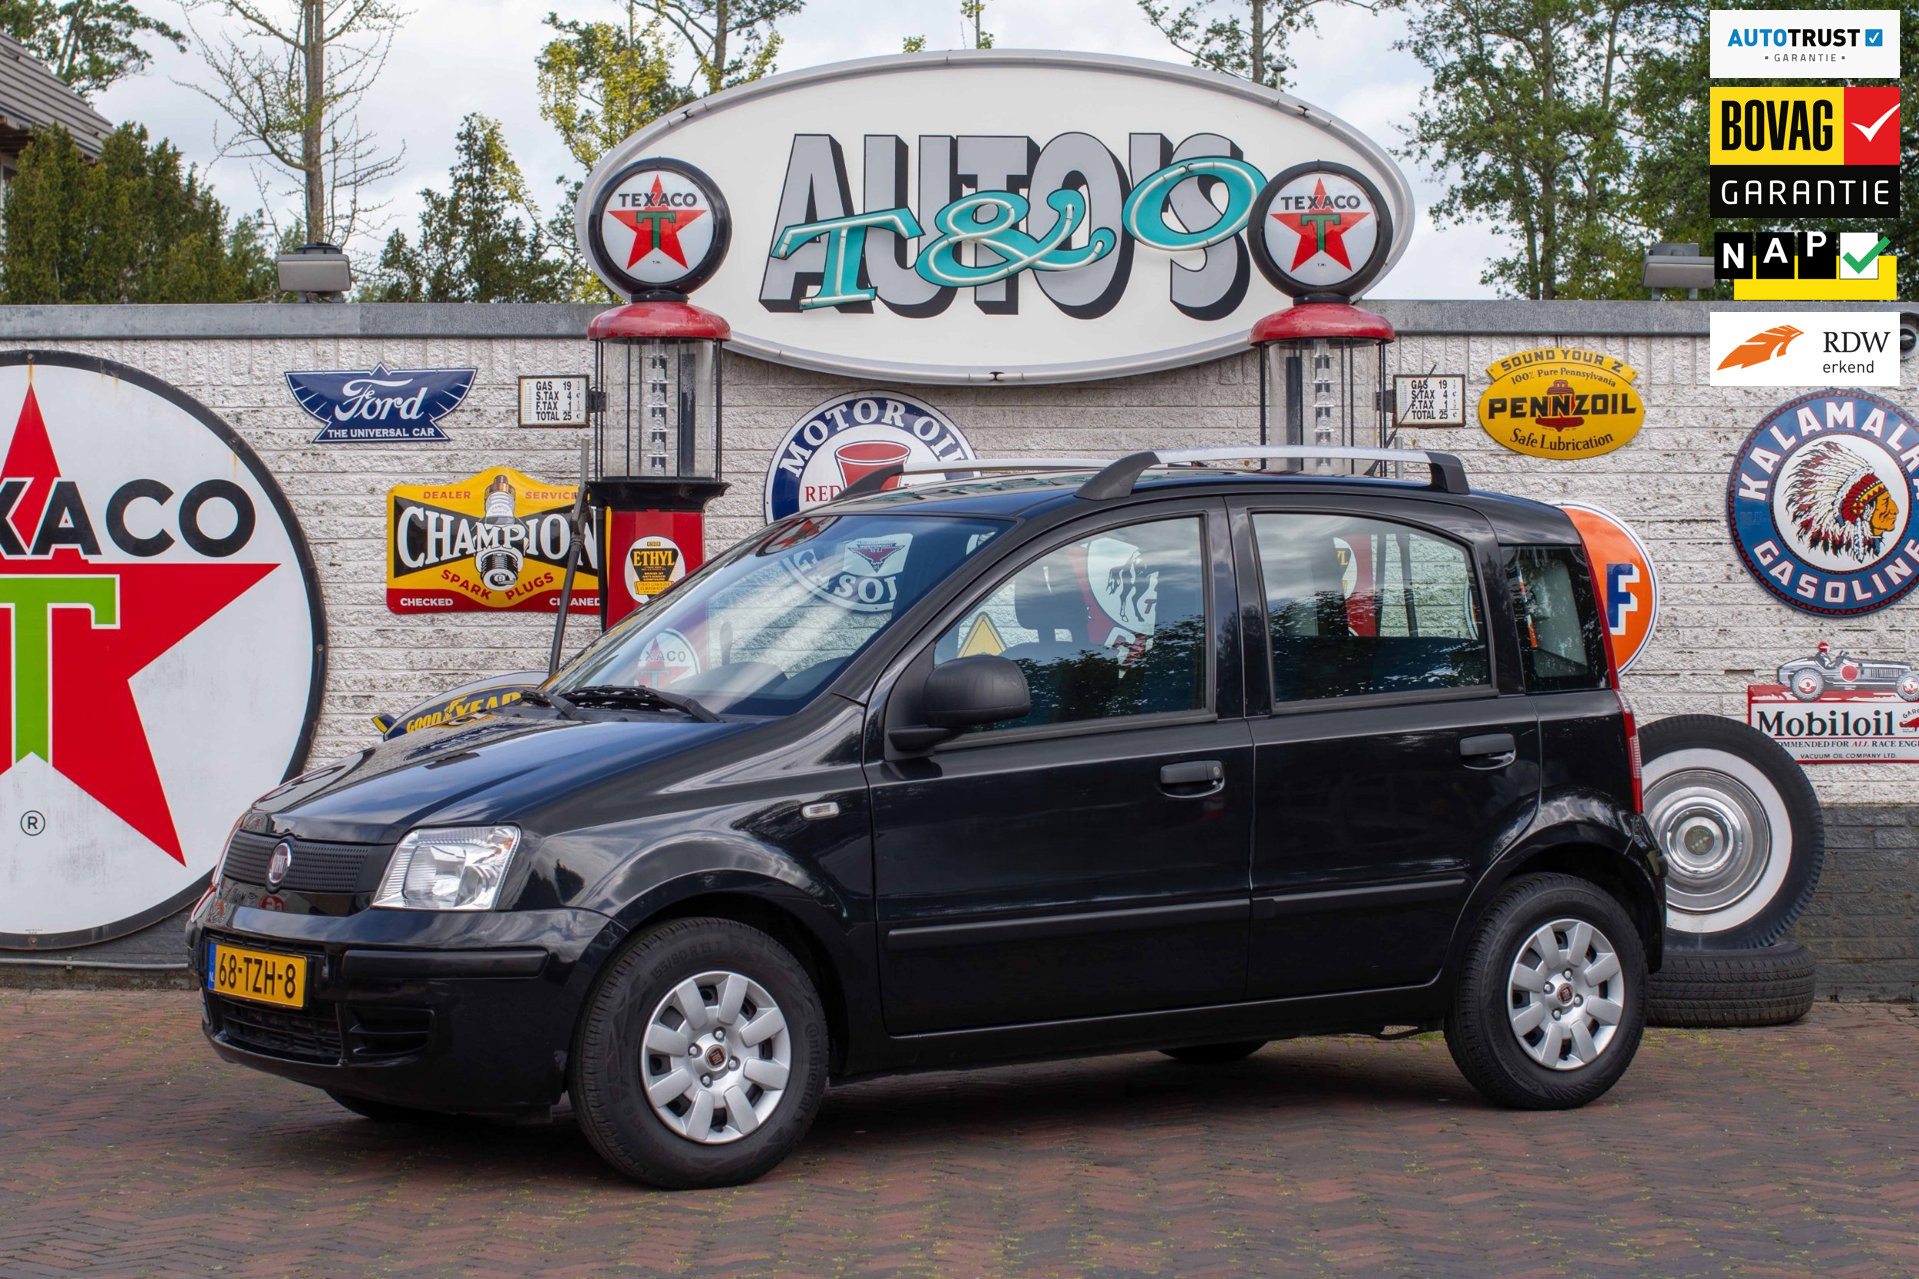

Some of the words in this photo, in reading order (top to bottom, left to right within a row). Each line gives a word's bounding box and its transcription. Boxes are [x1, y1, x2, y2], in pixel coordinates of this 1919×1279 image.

[618, 192, 698, 207] TEXACO
[1281, 195, 1361, 210] TEXACO
[637, 211, 677, 250] T
[758, 131, 1250, 320] AUTO'S
[1300, 213, 1341, 252] T
[1500, 350, 1556, 372] SOUND
[1561, 349, 1604, 365] YOUR
[1610, 360, 1624, 373] Z
[1411, 380, 1428, 390] GAS
[1439, 380, 1448, 389] 19
[1537, 368, 1558, 378] Pure
[1560, 367, 1616, 388] Pennsylvania
[536, 381, 553, 391] GAS
[563, 381, 572, 391] 19
[334, 378, 428, 421] Ford
[536, 391, 559, 401] S.TAX
[567, 391, 572, 400] 4
[1443, 390, 1448, 399] 4
[536, 401, 558, 411] F.TAX
[1488, 393, 1637, 420] PENNZOIL
[536, 411, 560, 421] TOTAL
[563, 411, 572, 421] 25
[1411, 410, 1436, 420] TOTAL
[1439, 410, 1448, 420] 25
[328, 429, 349, 438] THE
[350, 428, 410, 438] UNIVERSAL
[412, 427, 435, 437] CAR
[779, 399, 906, 478] MOTOR
[1509, 427, 1538, 447] Safe
[1540, 433, 1614, 451] Lubrication
[423, 491, 471, 499] DEALER
[805, 485, 842, 502] RED
[397, 505, 599, 570] CHAMPION
[633, 550, 675, 566] ETHYL
[440, 569, 492, 600] SPARK
[505, 572, 555, 600] PLUGS
[400, 597, 454, 607] CHECKED
[549, 597, 601, 606] CANED
[1757, 709, 1895, 737] Mobiloil
[1831, 740, 1849, 748] FOR
[1872, 740, 1897, 748] RACE
[219, 953, 296, 999] 68-TZH-8
